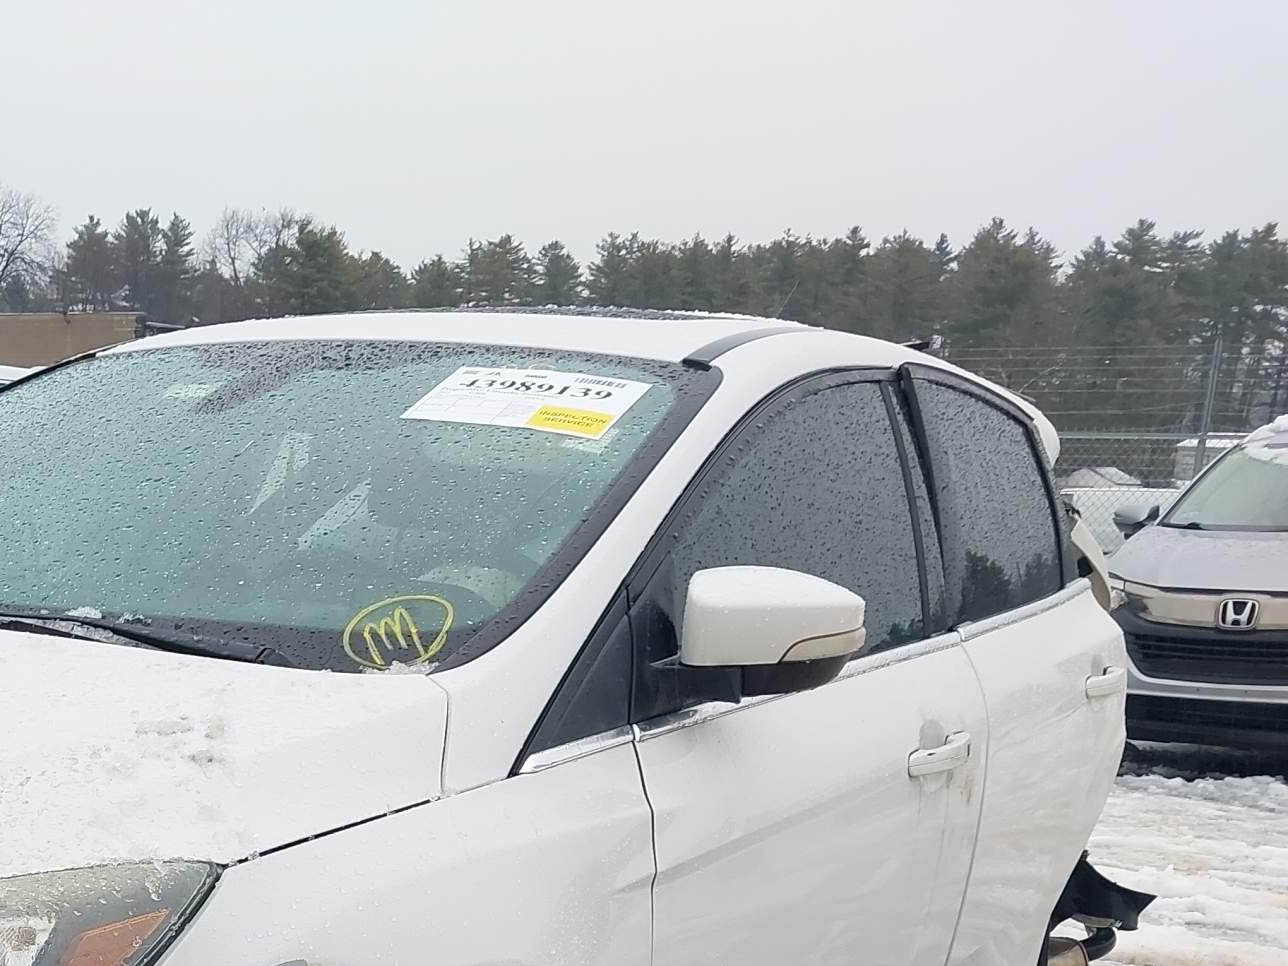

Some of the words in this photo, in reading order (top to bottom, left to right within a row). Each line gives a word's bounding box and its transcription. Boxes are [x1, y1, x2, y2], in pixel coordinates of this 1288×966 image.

[460, 378, 613, 400] 43989139
[539, 410, 608, 424] INSPECTION
[543, 416, 594, 428] SERVICE
